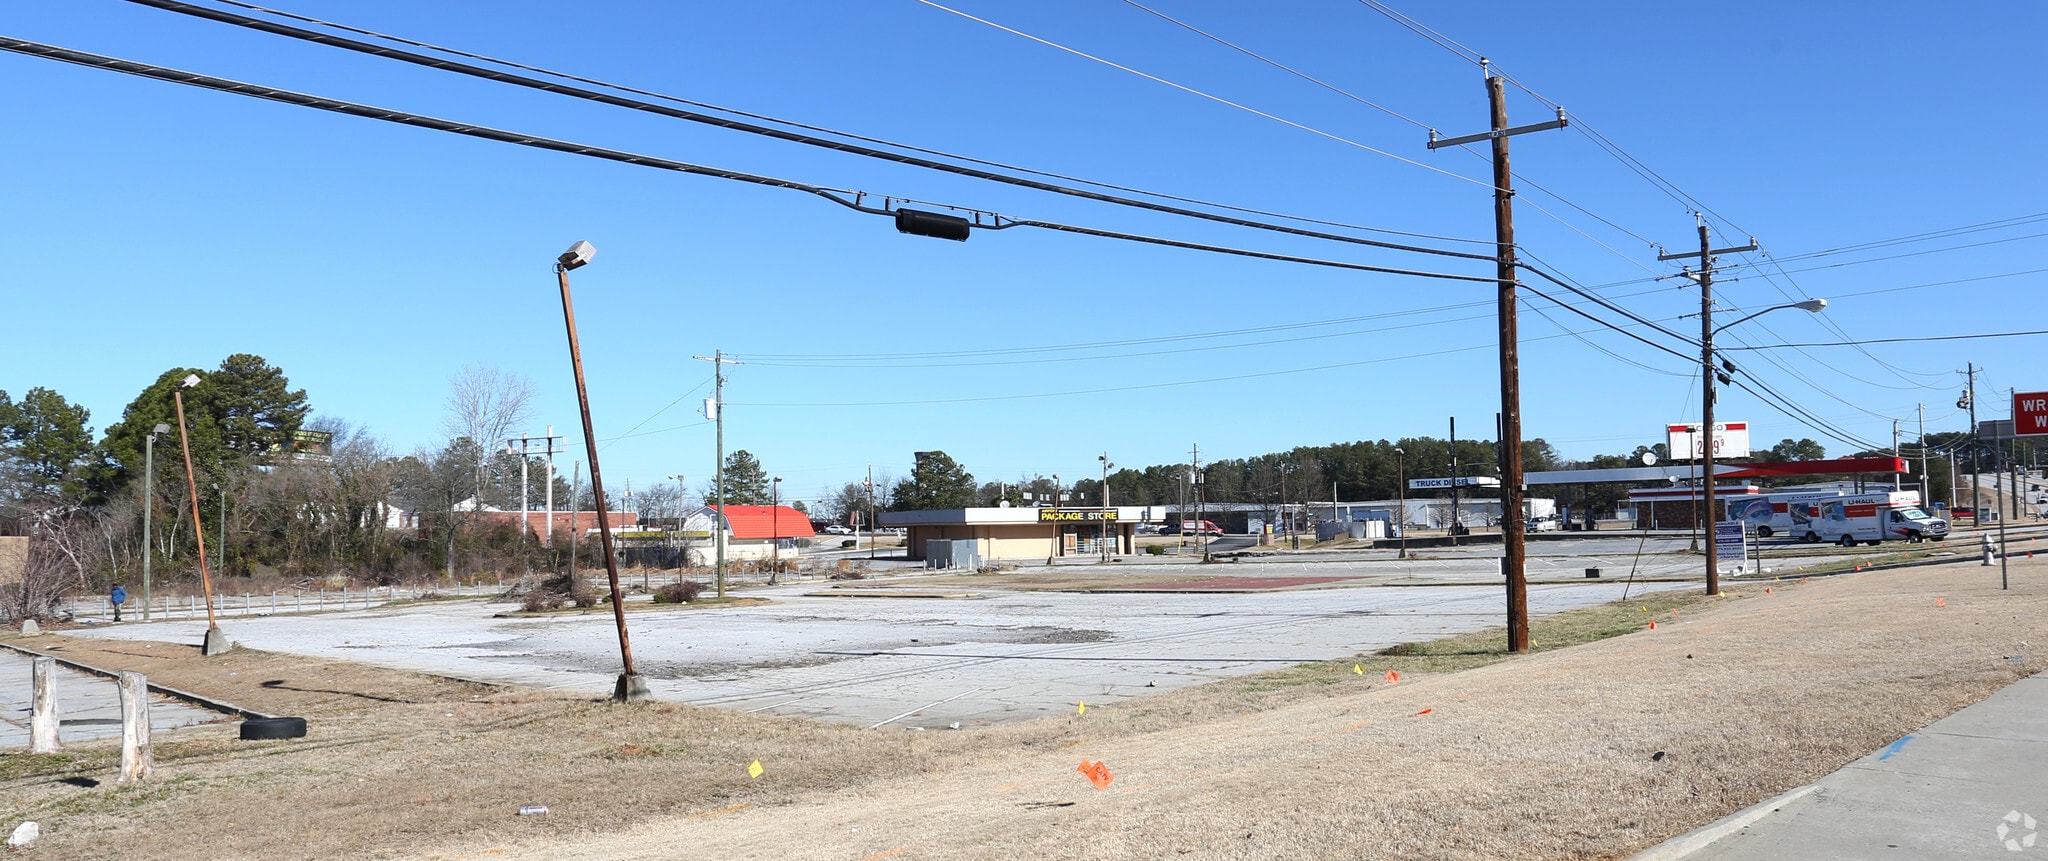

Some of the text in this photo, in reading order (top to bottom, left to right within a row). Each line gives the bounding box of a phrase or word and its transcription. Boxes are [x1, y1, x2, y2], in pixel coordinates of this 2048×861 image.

[1696, 424, 1724, 432] CGO
[1416, 478, 1469, 487] TRUCK DISEL
[1041, 512, 1084, 520] PACKAGE
[1095, 766, 1110, 781] CATV
